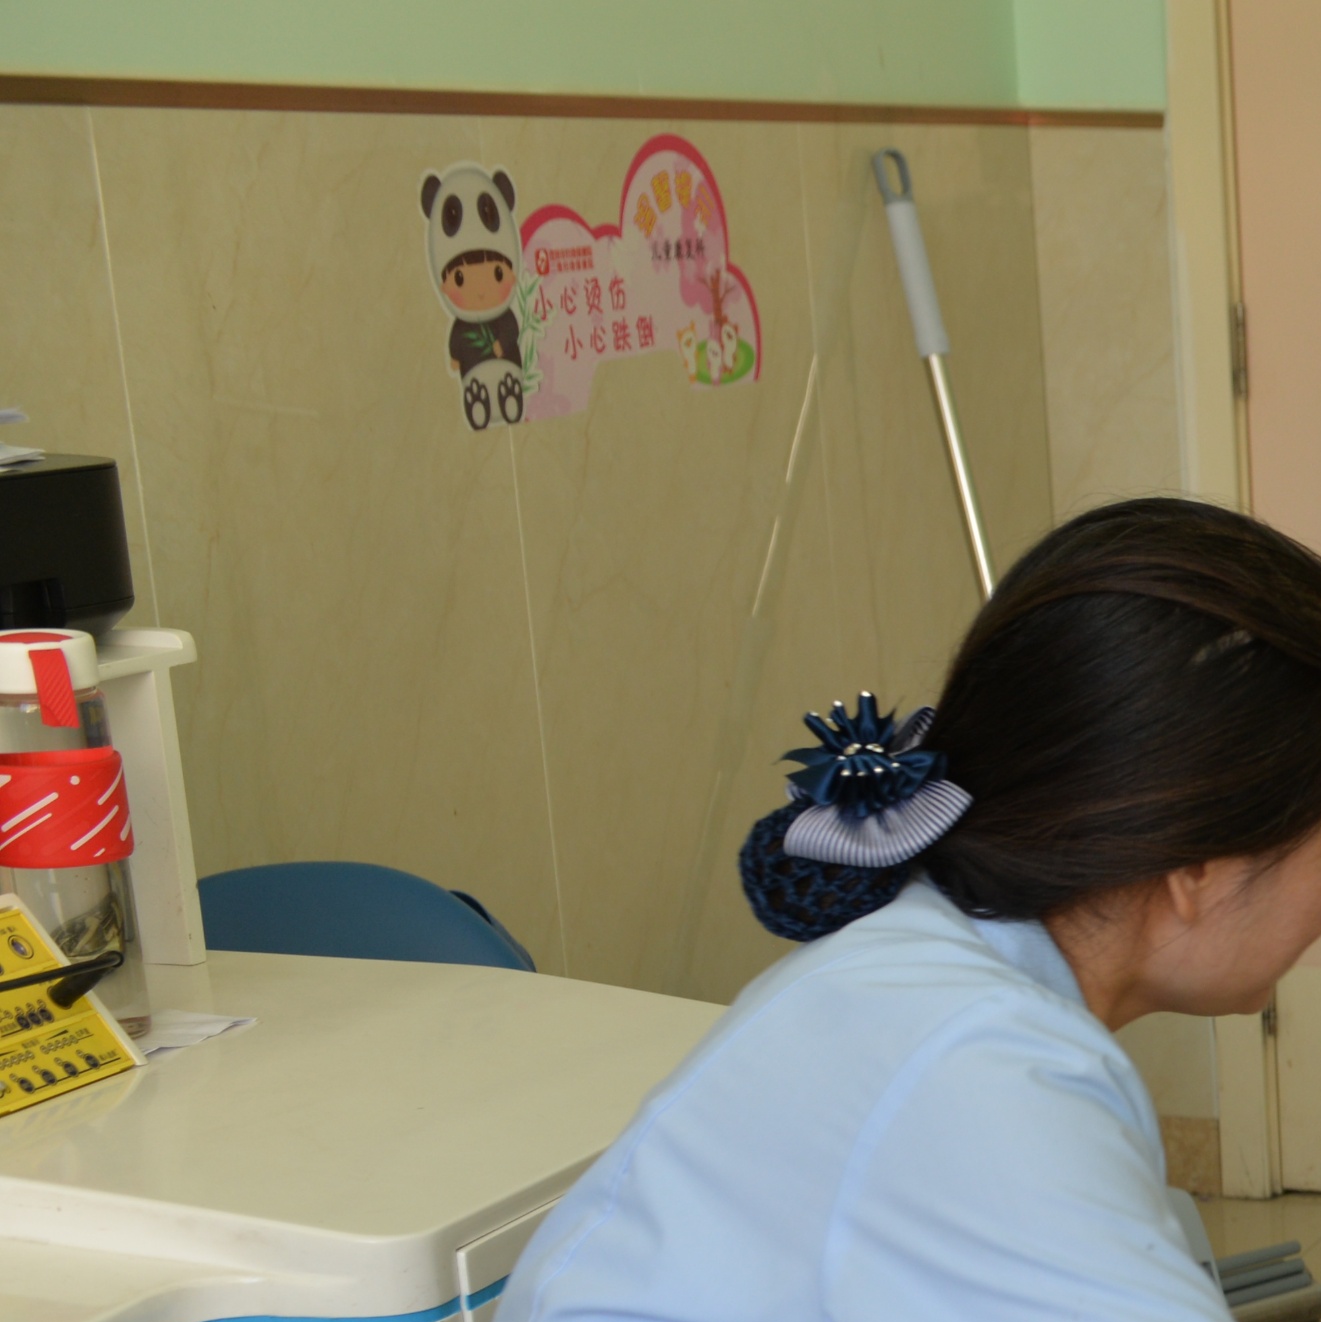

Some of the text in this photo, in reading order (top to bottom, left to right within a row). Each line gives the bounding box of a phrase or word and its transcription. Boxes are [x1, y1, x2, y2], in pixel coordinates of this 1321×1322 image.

[535, 277, 626, 321] 小心烫伤
[565, 315, 654, 359] 小心跌倒
